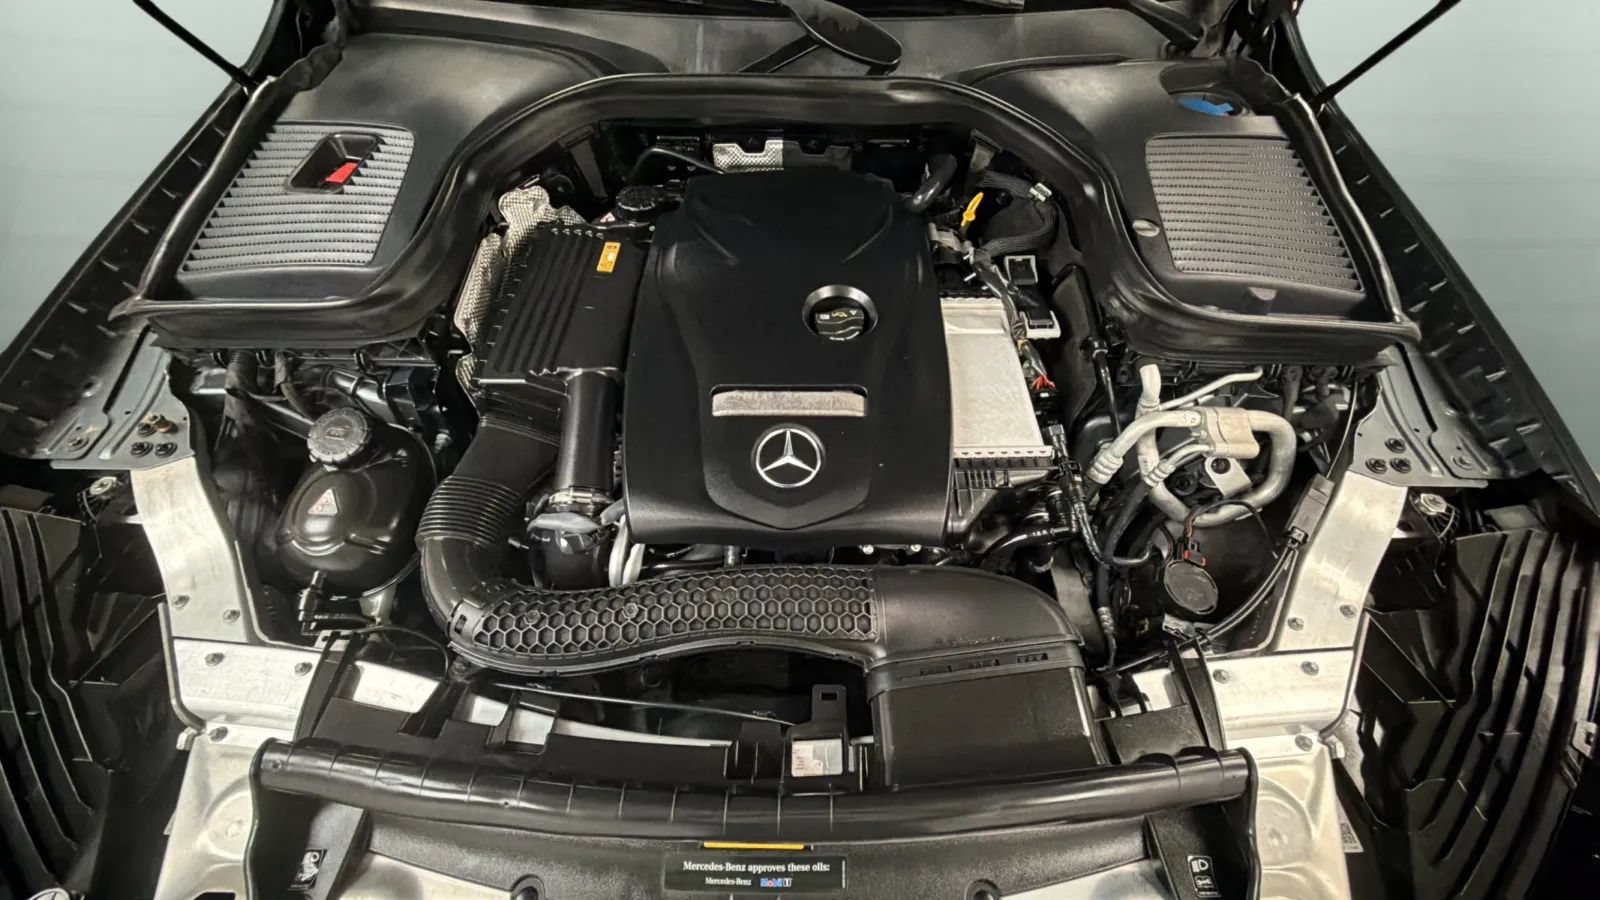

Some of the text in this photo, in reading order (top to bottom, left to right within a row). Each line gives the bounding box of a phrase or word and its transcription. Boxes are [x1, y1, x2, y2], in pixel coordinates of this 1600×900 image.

[683, 861, 830, 874] Mercedes-Benz approves these oils:
[705, 877, 752, 886] Mercedes-Benz
